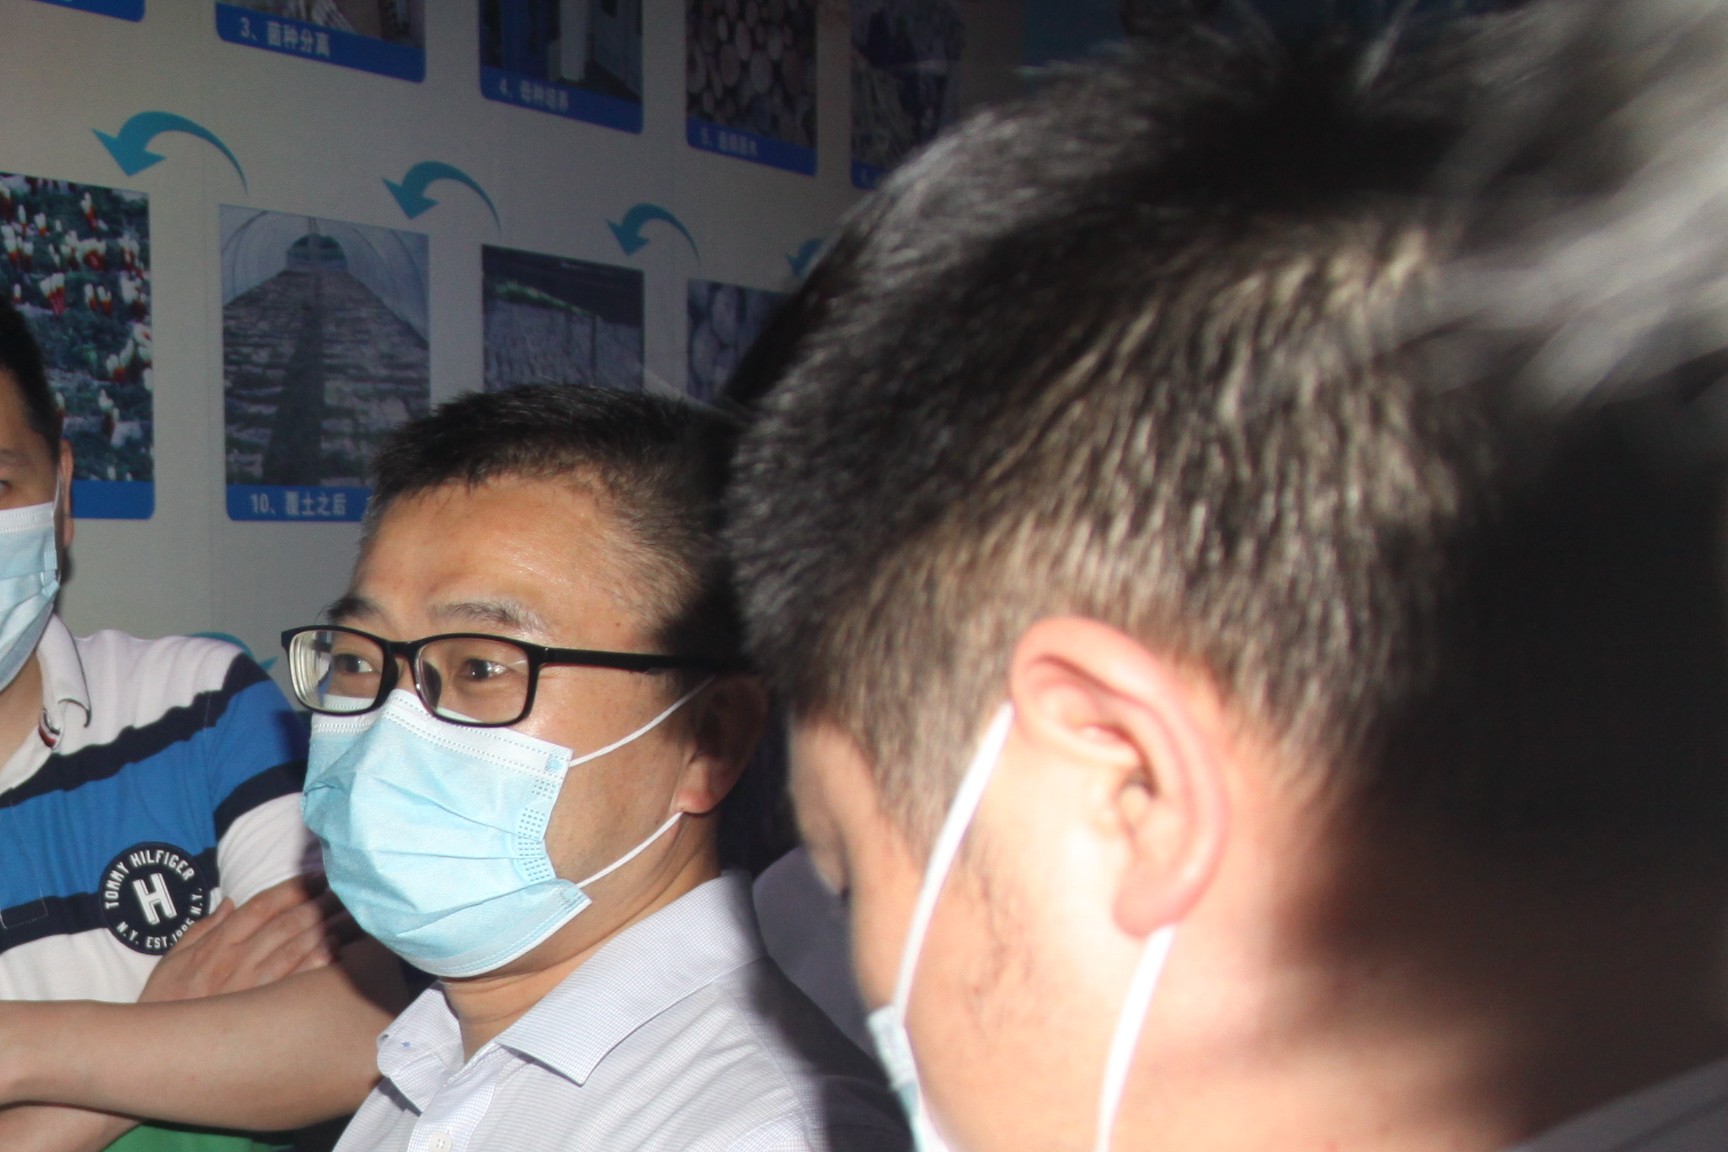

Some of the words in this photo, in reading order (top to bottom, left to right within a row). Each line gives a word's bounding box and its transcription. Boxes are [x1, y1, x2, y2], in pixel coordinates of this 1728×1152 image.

[104, 861, 130, 910] TOMMY
[129, 849, 195, 881] HILFIGER
[132, 872, 178, 926] H
